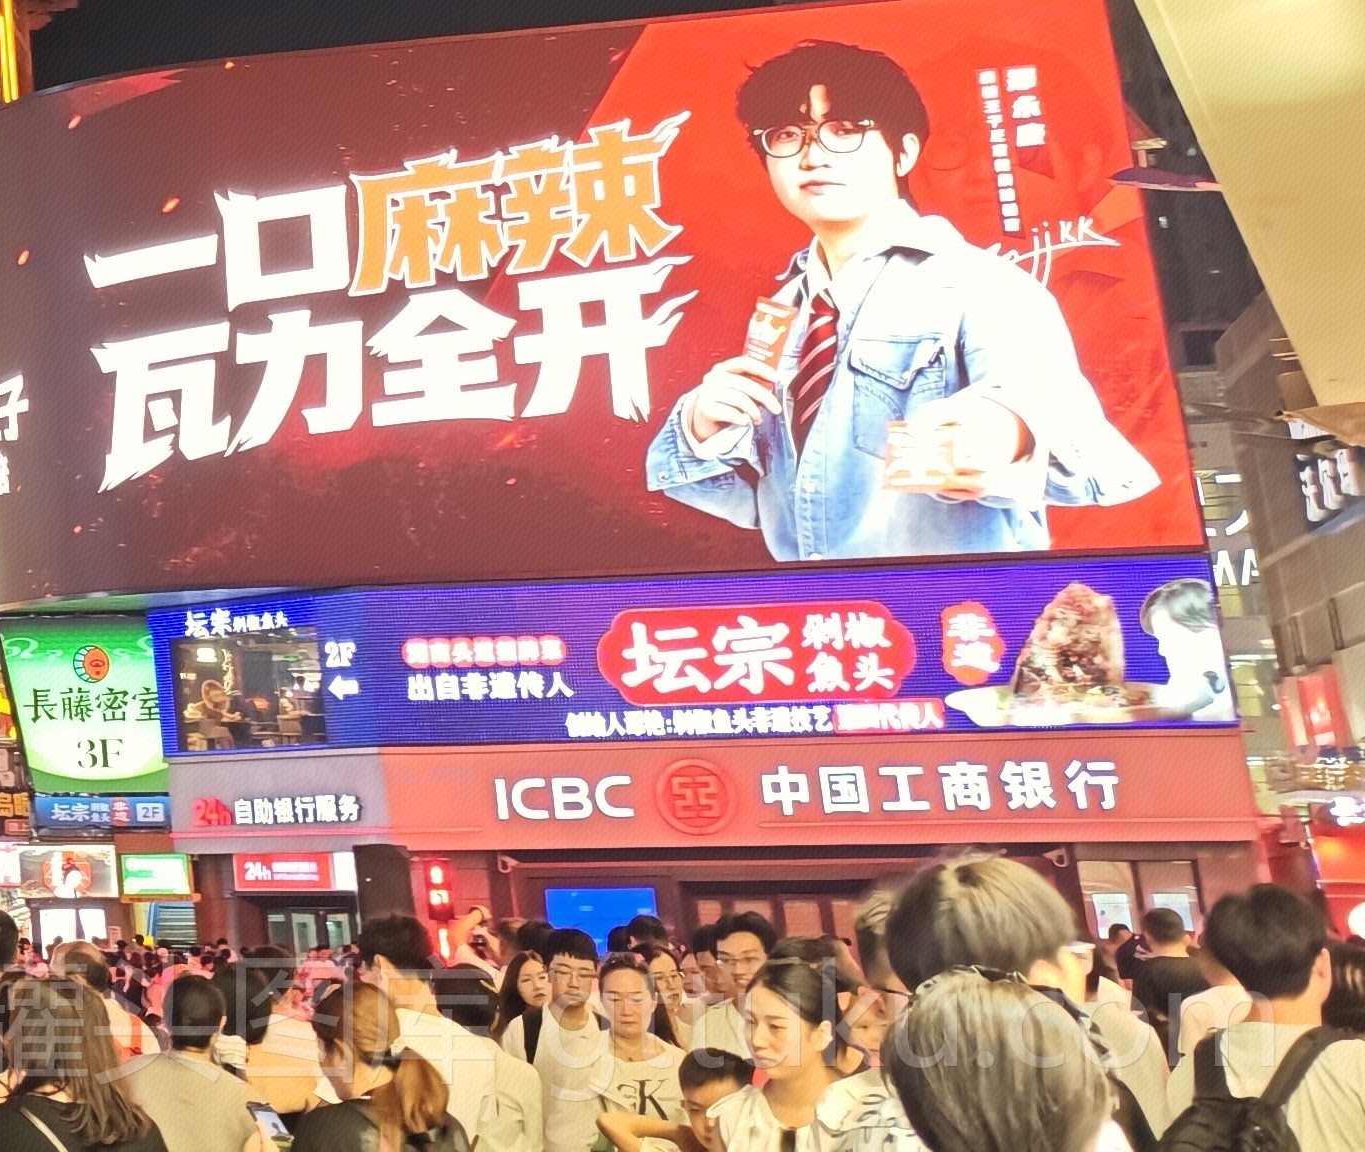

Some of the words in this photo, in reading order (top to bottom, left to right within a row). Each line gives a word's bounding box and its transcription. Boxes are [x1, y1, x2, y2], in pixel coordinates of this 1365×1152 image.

[84, 111, 691, 312] 一口麻辣
[90, 256, 698, 494] 瓦力全开
[801, 611, 893, 650] 剁椒
[324, 641, 357, 668] 2F
[621, 615, 796, 695] 坛宗
[76, 738, 124, 769] 3F
[493, 774, 636, 822] ICBC
[760, 760, 1120, 818] 中国工商银行
[141, 806, 161, 819] 2F
[192, 798, 233, 828] 24h
[233, 794, 360, 826] 自助银行服务
[243, 861, 272, 882] 24h
